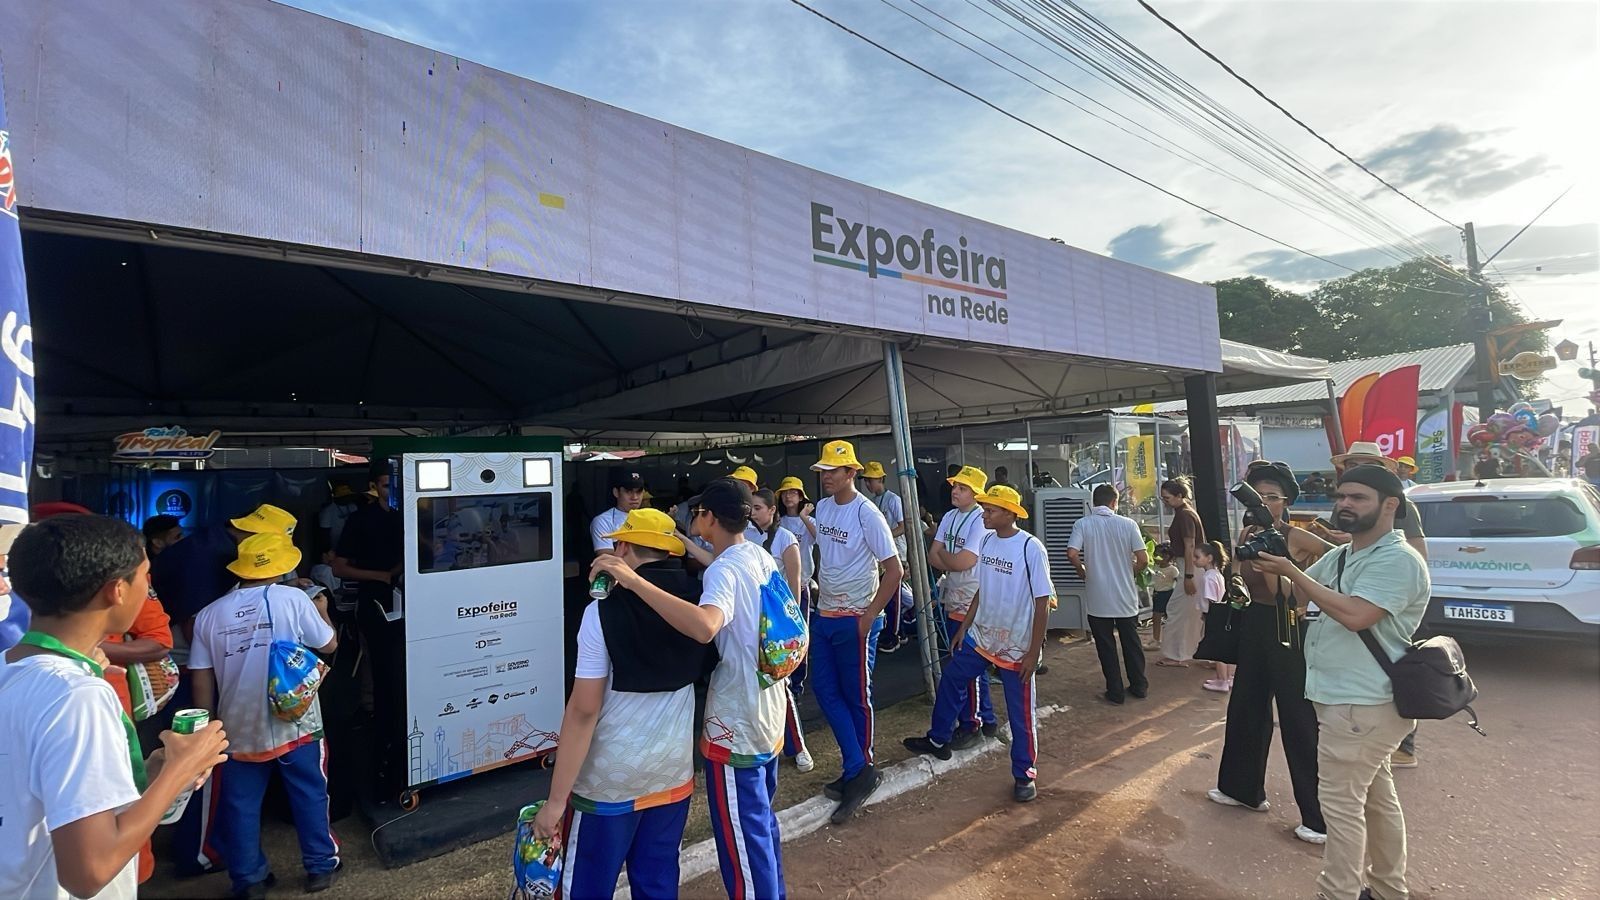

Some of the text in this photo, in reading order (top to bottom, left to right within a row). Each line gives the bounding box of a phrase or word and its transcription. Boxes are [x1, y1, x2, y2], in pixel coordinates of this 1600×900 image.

[811, 201, 1007, 290] Expofeira
[927, 293, 1009, 325] na Rede
[115, 431, 220, 453] Tropical
[1376, 429, 1405, 456] g1
[458, 600, 517, 618] Expofeira
[500, 611, 517, 619] Rede
[1451, 607, 1506, 621] TAH3C83
